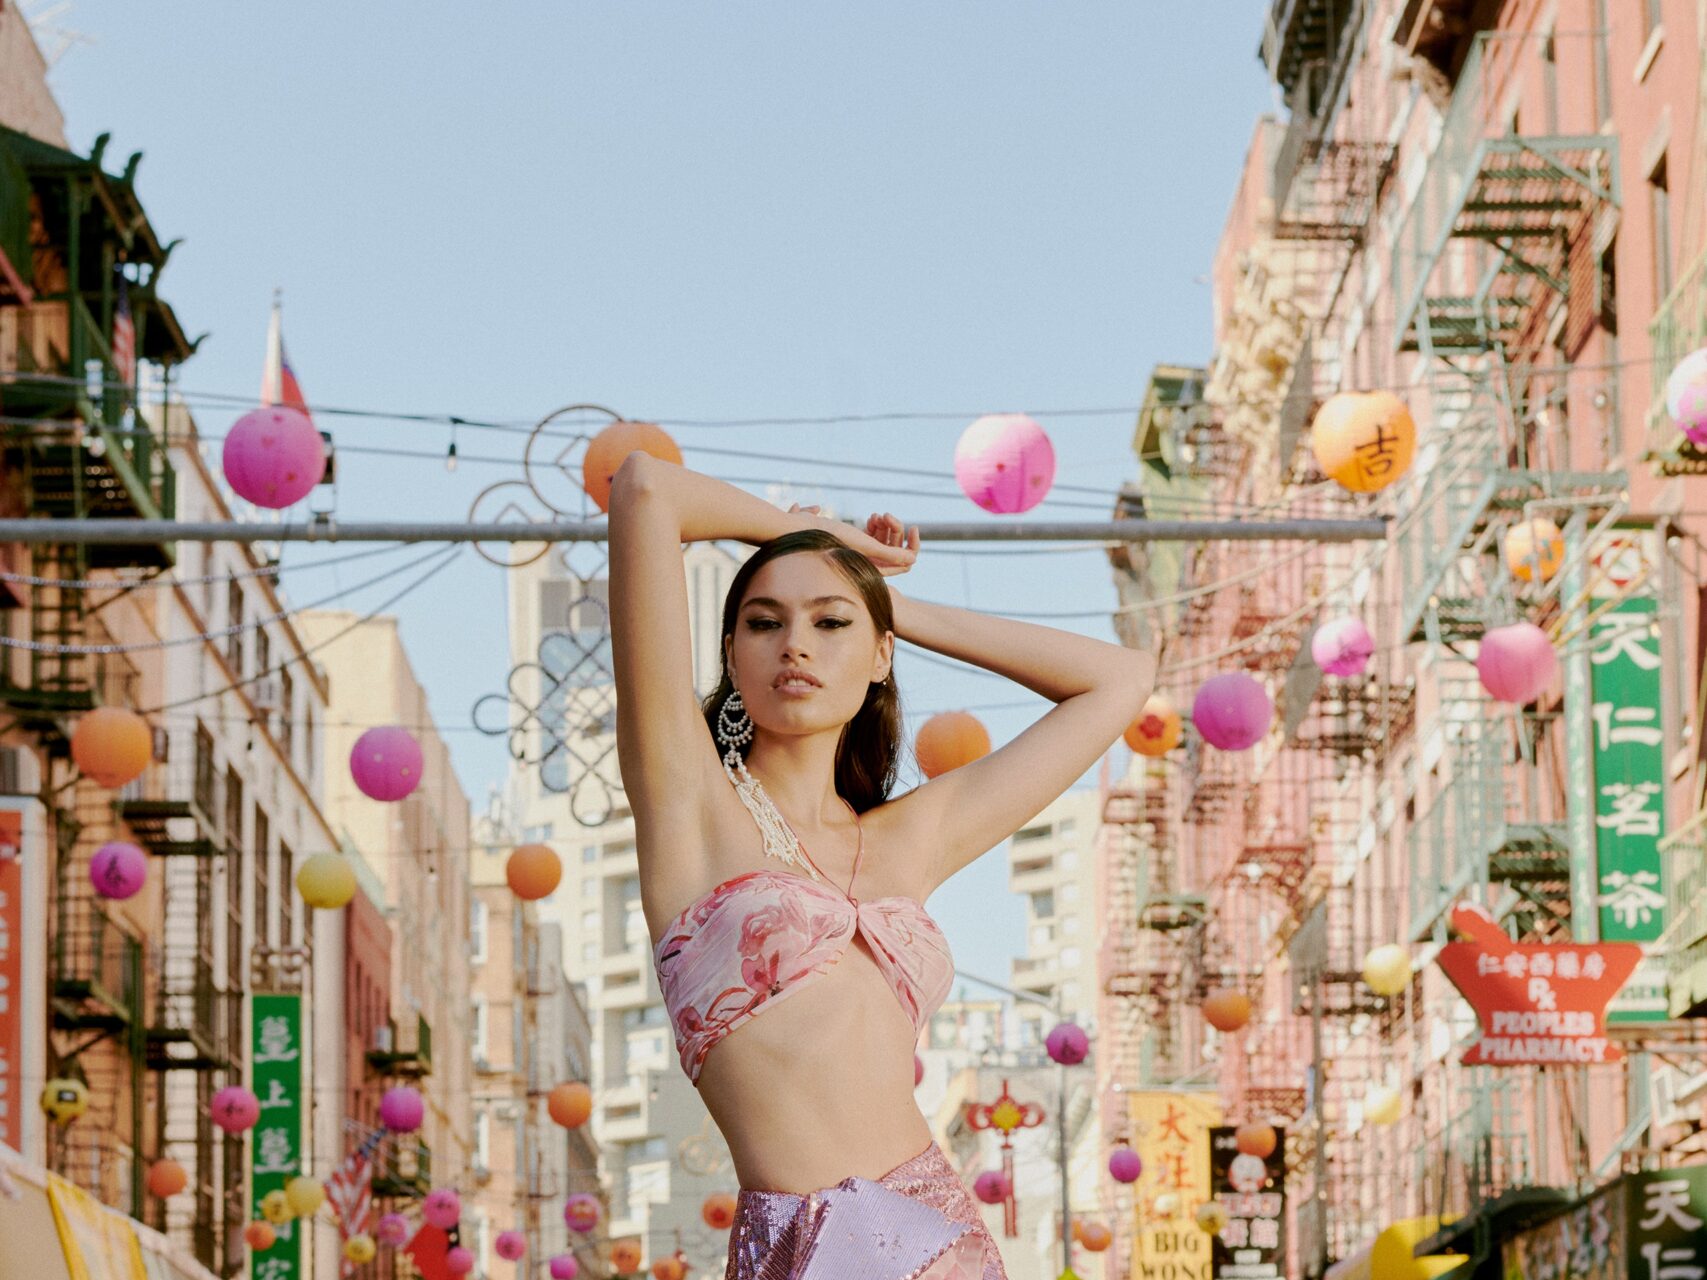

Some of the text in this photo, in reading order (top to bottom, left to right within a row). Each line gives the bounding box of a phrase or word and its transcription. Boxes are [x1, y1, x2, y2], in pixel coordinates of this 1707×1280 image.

[1354, 424, 1398, 477] 吉
[1592, 611, 1666, 930] 天仁茗茶
[1492, 1011, 1596, 1036] PEOPLES
[1479, 1037, 1608, 1062] PHARMACY
[1155, 1233, 1198, 1253] BIG
